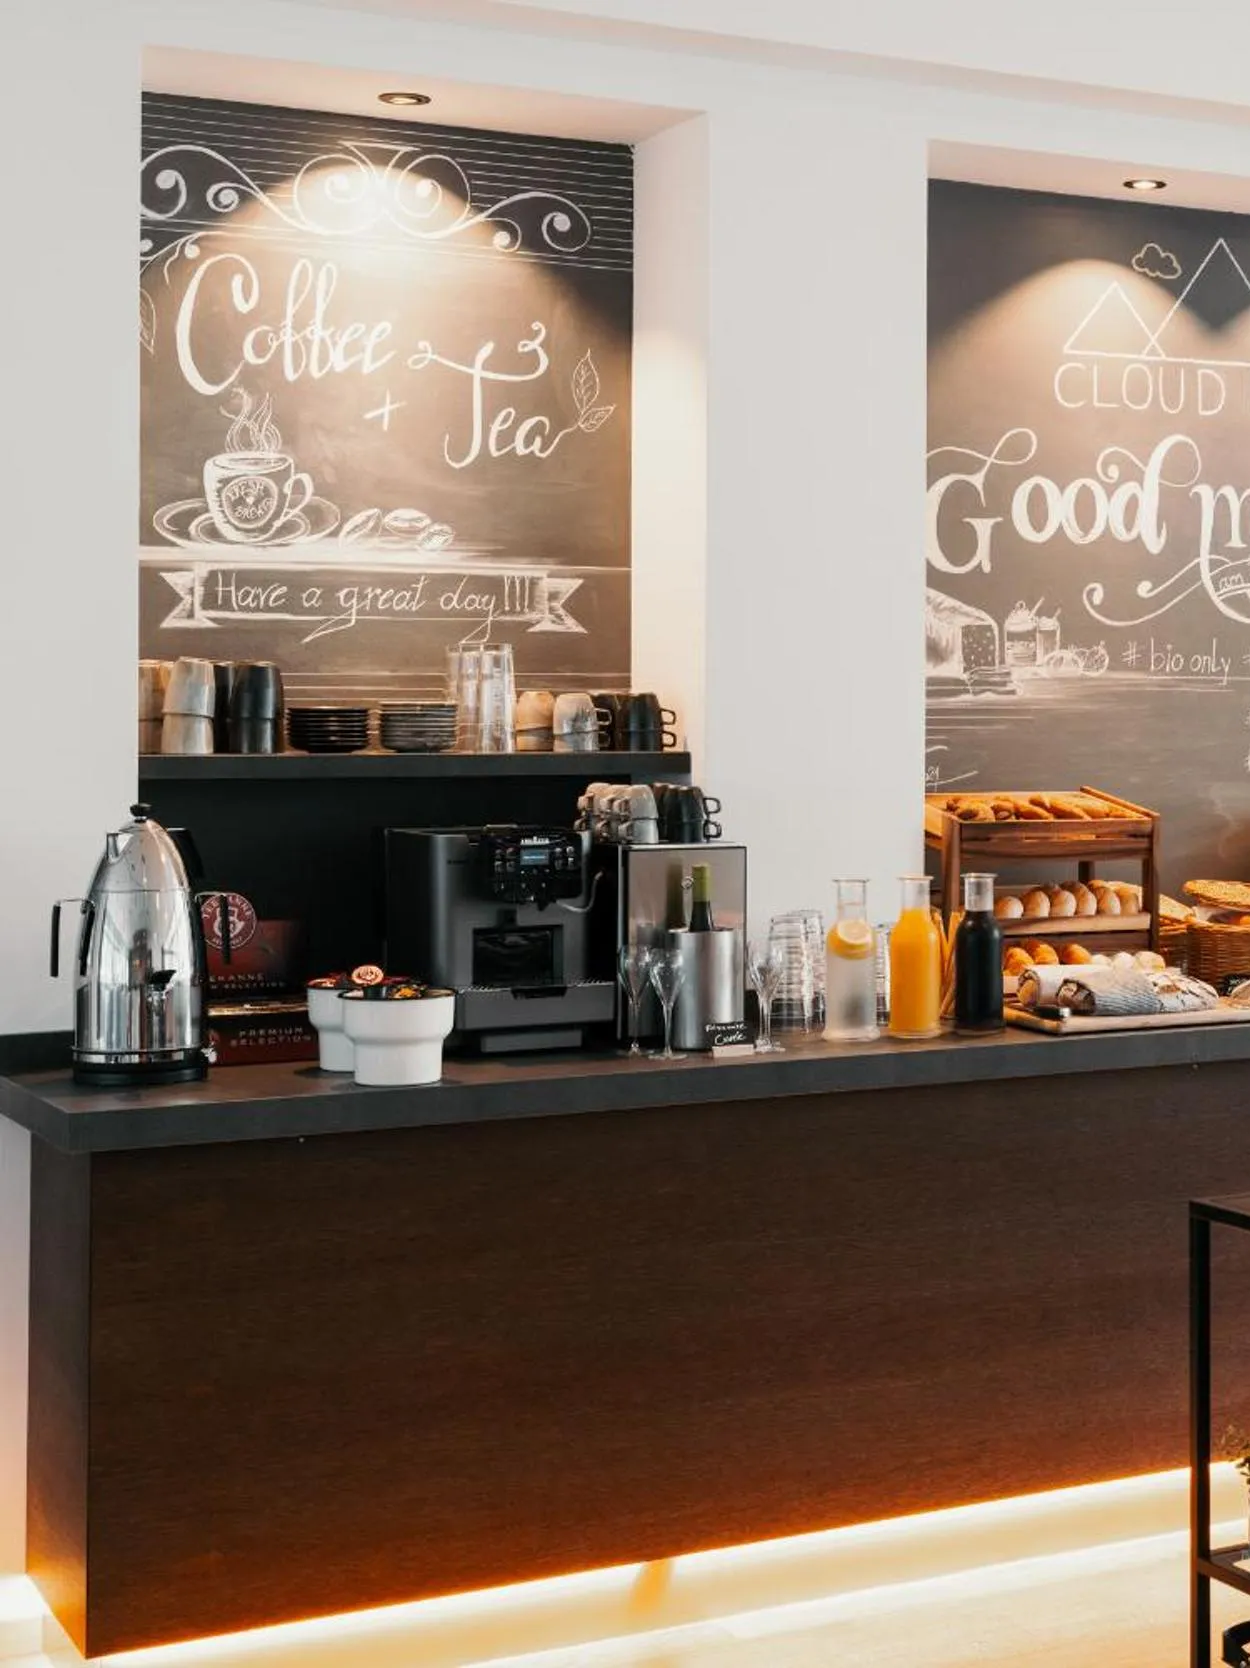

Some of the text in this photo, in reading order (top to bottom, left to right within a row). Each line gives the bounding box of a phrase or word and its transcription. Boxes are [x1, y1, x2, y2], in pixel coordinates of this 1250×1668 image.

[176, 253, 397, 396] Coffee
[363, 390, 407, 431] +
[408, 322, 564, 469] Tea
[1053, 361, 1226, 416] CLOUD
[927, 428, 1201, 575] Good
[215, 570, 288, 611] Have
[302, 586, 324, 608] a
[1189, 637, 1231, 686] only
